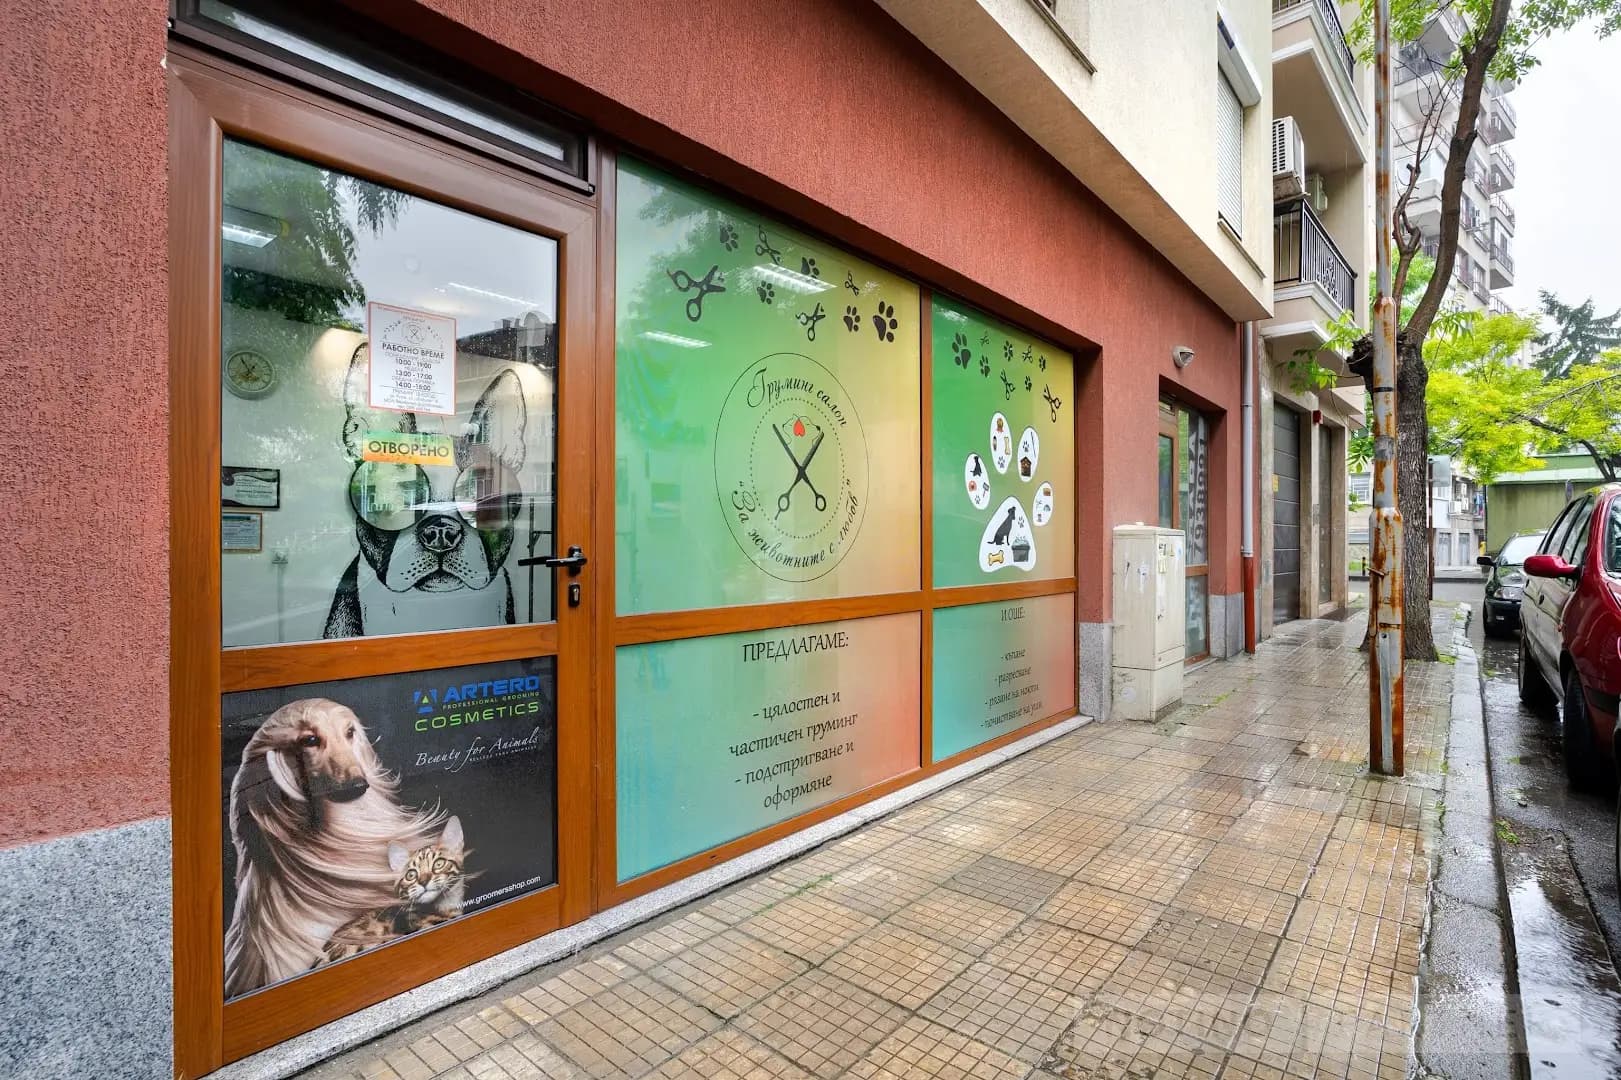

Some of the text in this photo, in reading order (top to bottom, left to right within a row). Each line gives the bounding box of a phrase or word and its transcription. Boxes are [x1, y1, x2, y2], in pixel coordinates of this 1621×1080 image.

[382, 343, 420, 356] РАБОТНО
[421, 349, 446, 360] ВРЕМЕ
[395, 358, 412, 367] 10:00
[416, 361, 432, 370] 19:00
[395, 370, 412, 378] 13:00
[417, 372, 433, 380] 17:00
[395, 381, 412, 389] 14:00
[746, 367, 848, 427] Груминг салон
[368, 440, 450, 458] ОТВОРЕНО
[748, 529, 826, 568] животните
[1001, 609, 1007, 622] И
[742, 631, 849, 662] ПРЕДЛАГАМЕ:
[442, 675, 541, 704] ARTERO
[442, 691, 540, 711] PROFESSIONAL GROOMING
[414, 702, 540, 732] COSMETICS
[762, 693, 830, 722] цялостен
[832, 690, 841, 703] и
[416, 748, 461, 770] Beauty
[489, 726, 540, 753] Animals
[729, 713, 858, 757] частичен груминг
[745, 743, 844, 785] подстригване
[845, 741, 855, 753] и
[764, 774, 833, 810] оформяне
[456, 875, 542, 910] www.groomersshop.com
